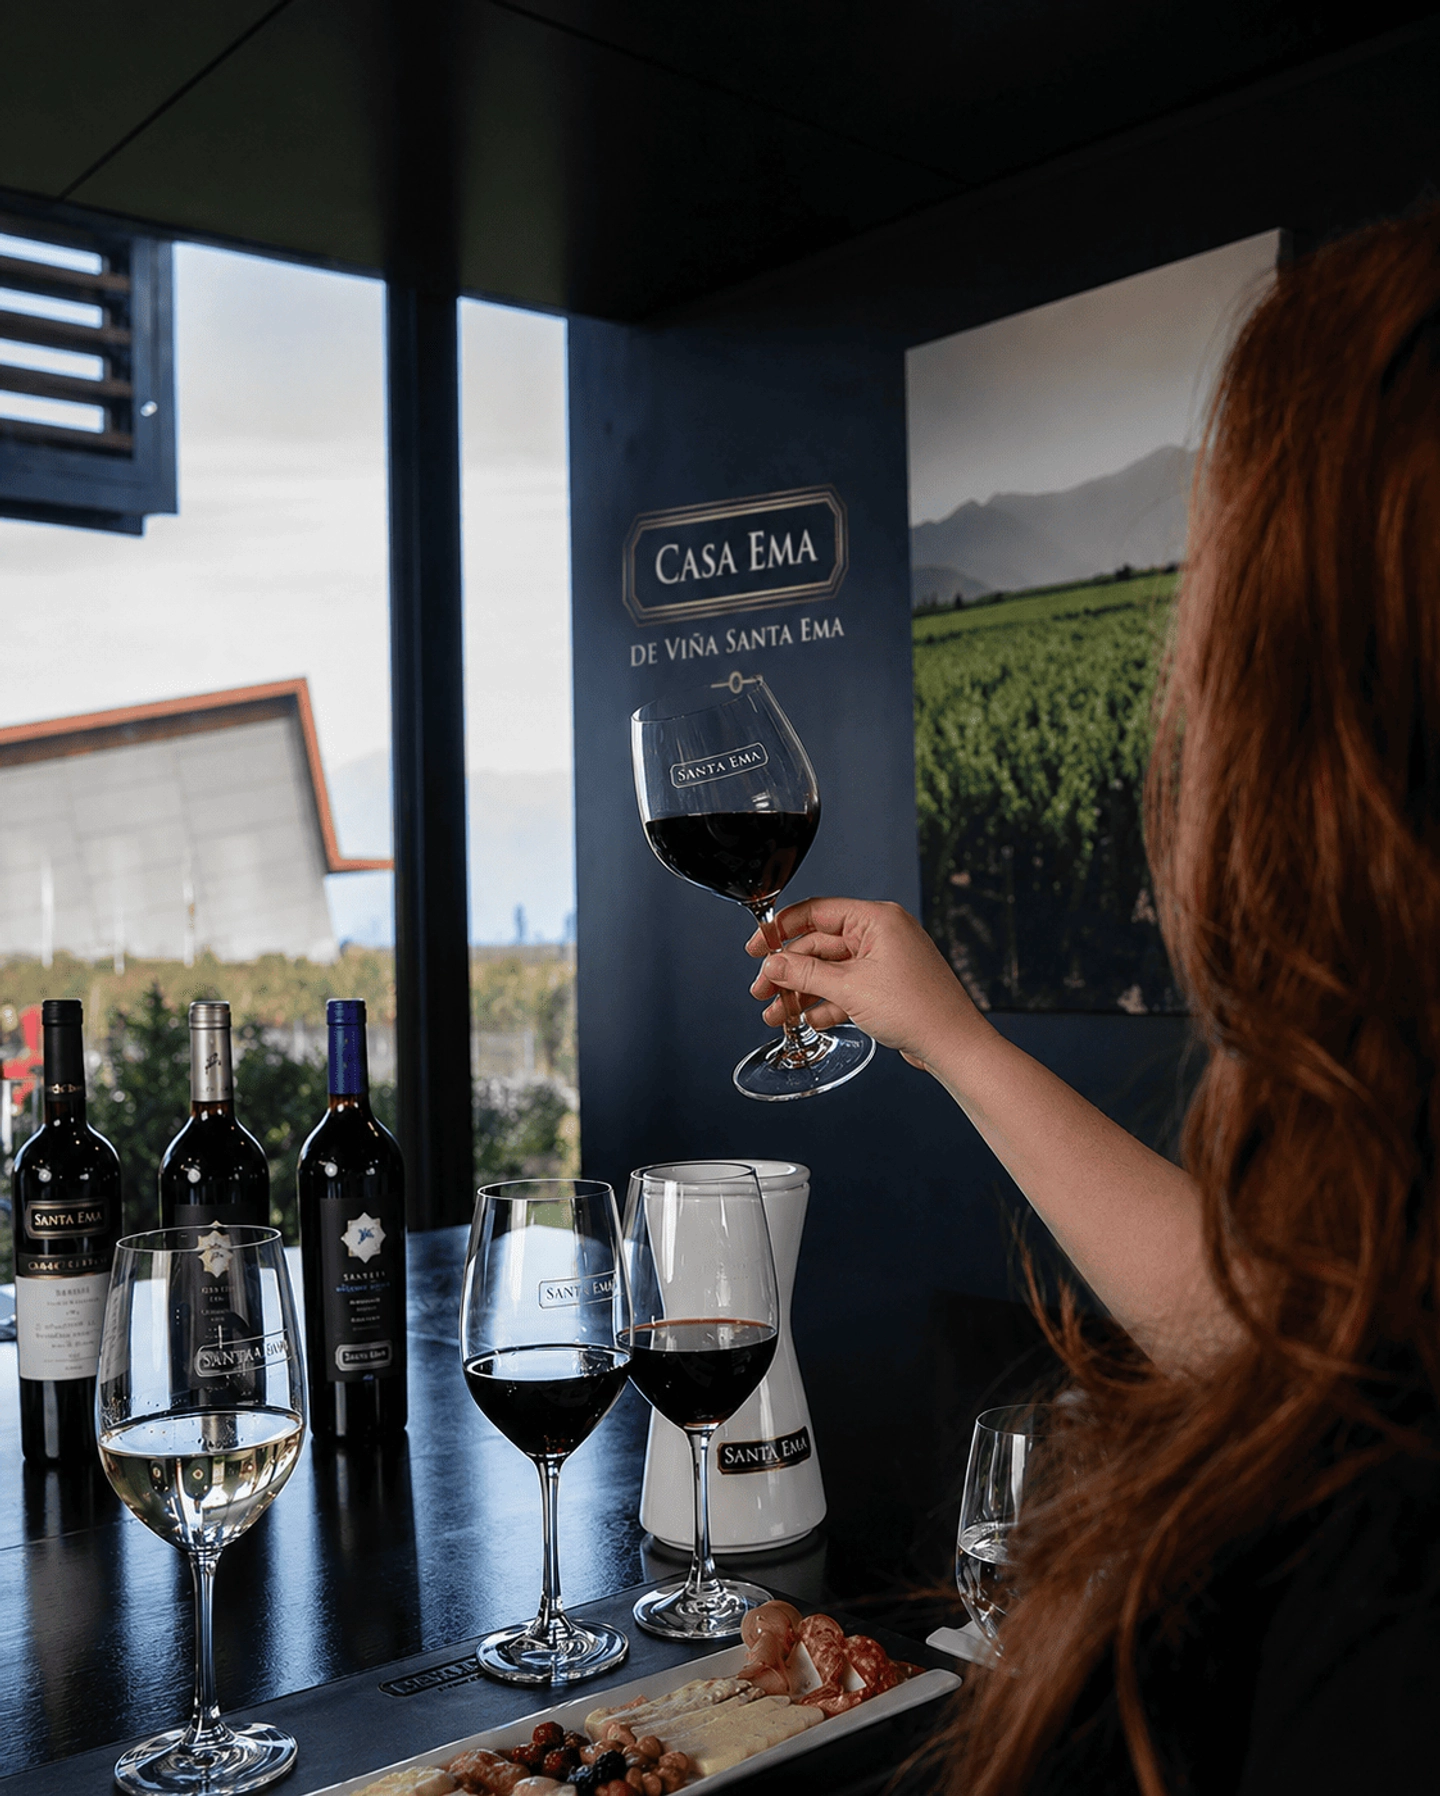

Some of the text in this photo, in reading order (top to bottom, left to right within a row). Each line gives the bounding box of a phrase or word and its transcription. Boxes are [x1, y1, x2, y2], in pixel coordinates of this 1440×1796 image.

[655, 528, 819, 585] CASA EMA
[630, 617, 845, 667] DE VIÑA SANTA EMA
[678, 751, 761, 782] SANTA EMA
[34, 1211, 102, 1226] SANTA EMA
[724, 1437, 808, 1464] SANTA EMA
